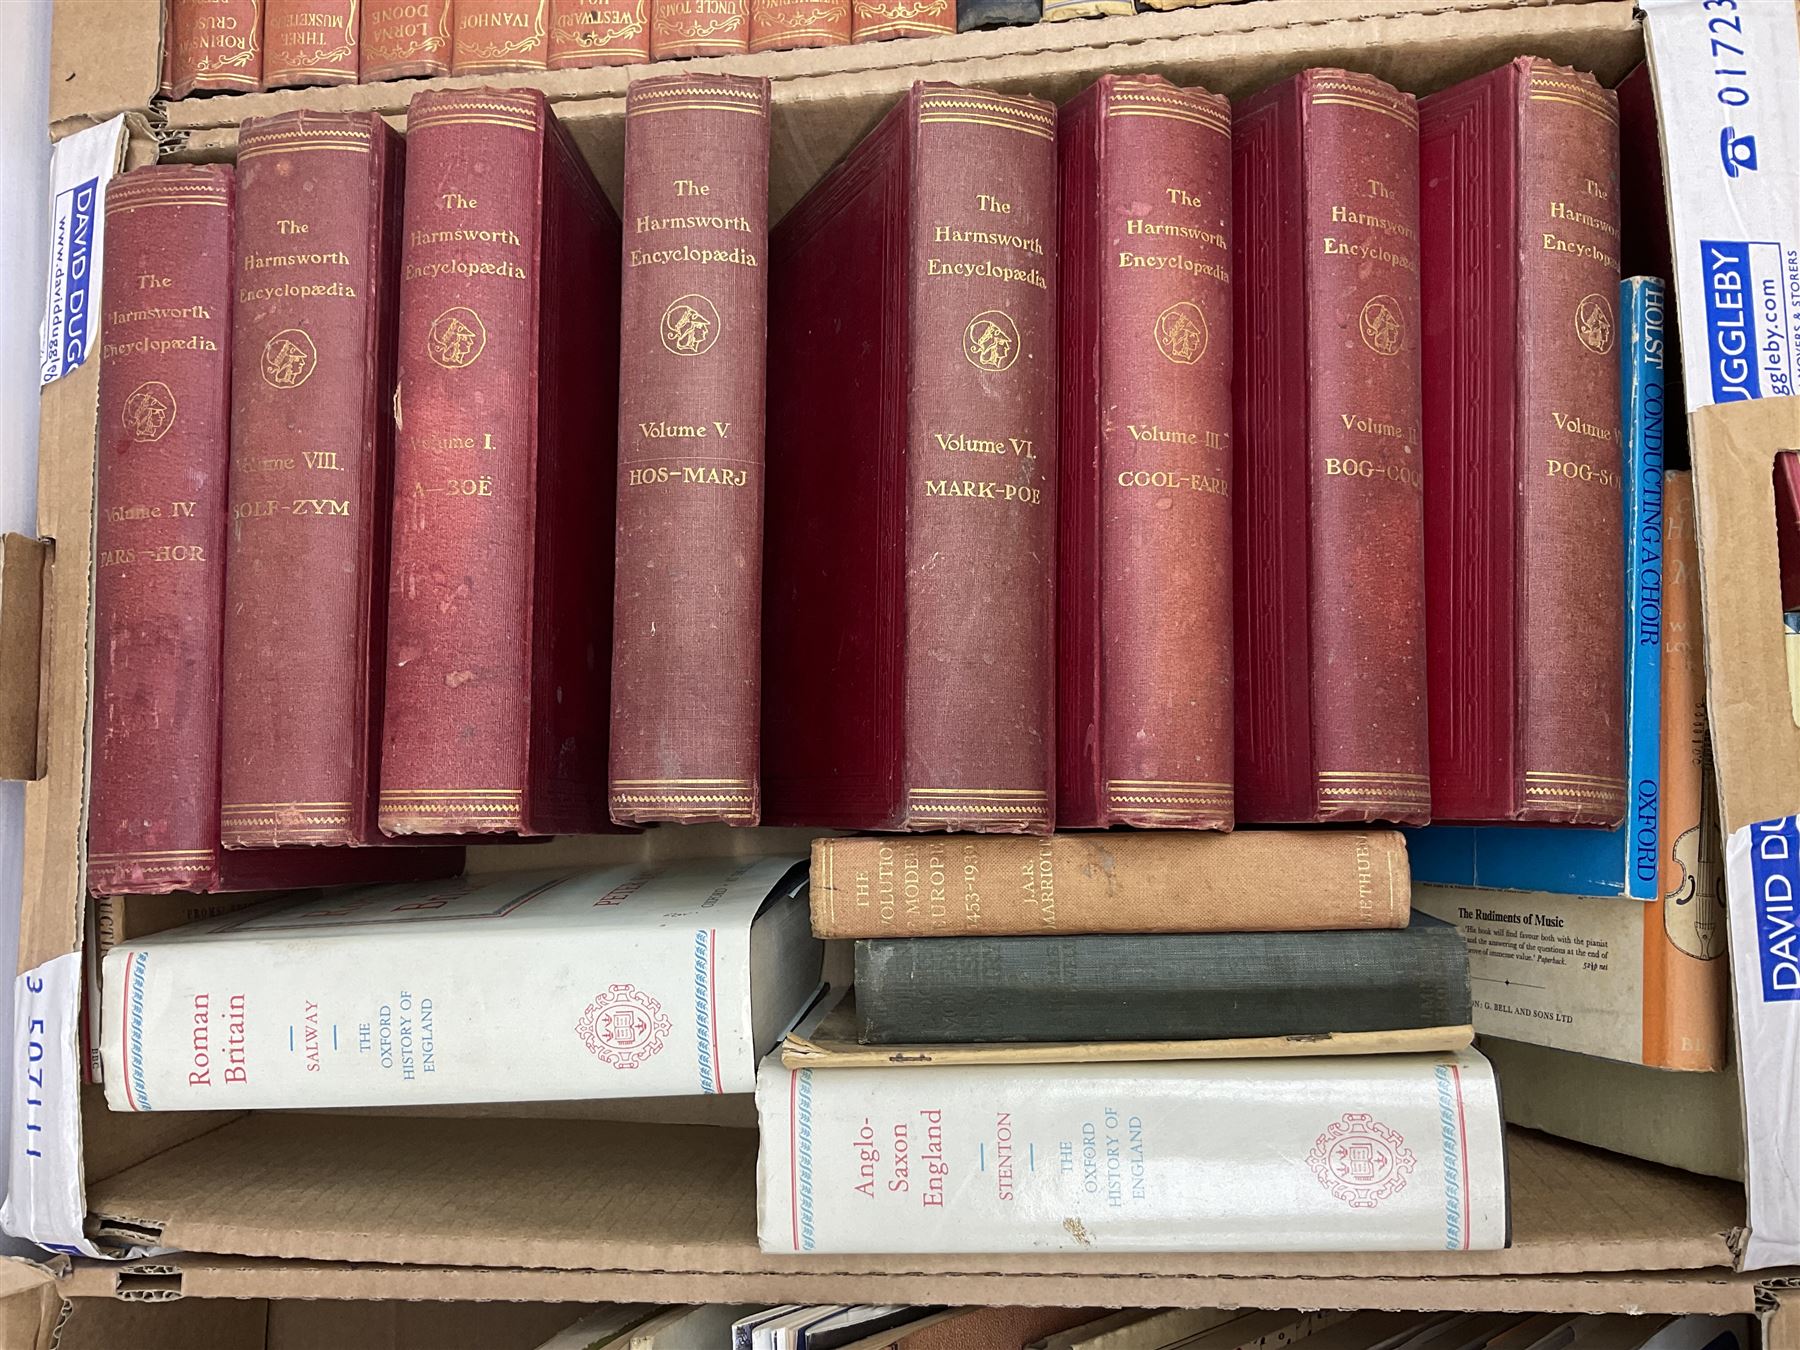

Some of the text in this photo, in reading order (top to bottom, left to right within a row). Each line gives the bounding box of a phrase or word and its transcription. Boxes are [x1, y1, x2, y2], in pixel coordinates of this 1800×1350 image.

[372, 5, 428, 25] DOONE
[558, 10, 633, 27] WESTWARD
[696, 0, 736, 15] UNCLE
[374, 23, 427, 42] LORNA
[674, 180, 710, 196] The
[1166, 188, 1202, 208] The
[1585, 179, 1608, 200] The
[442, 194, 478, 209] The
[976, 195, 1011, 214] The
[71, 188, 92, 281] DAVID
[277, 219, 309, 235] The
[636, 215, 751, 234] Harmsworth
[1126, 219, 1227, 250] Harmsworth
[411, 229, 521, 248] Harmsworth
[934, 226, 1044, 256] Harmsworth
[244, 251, 350, 271] Harmsworth
[630, 246, 758, 268] Encyclopædia
[1119, 252, 1230, 284] Encyclopædia
[138, 274, 172, 289] The
[406, 259, 526, 281] Encyclopædia
[927, 259, 1047, 290] Encyclopædia
[239, 282, 356, 304] Encyclopædia
[639, 421, 731, 439] Volume V.
[1127, 425, 1197, 445] Volume
[1341, 414, 1403, 438] Volume
[1551, 412, 1612, 440] Volume
[935, 434, 1006, 454] Volume
[629, 467, 748, 487] HOS-MARJ
[925, 480, 1041, 505] MARK-POE
[1637, 290, 1665, 883] HOLST CONDUCTING A CHOIR OXFORD
[1022, 860, 1038, 905] J.A.R.
[1458, 907, 1564, 928] The Rudiments of Music
[1478, 927, 1491, 936] book
[1493, 928, 1504, 937] will
[1506, 930, 1517, 938] find
[1519, 931, 1539, 941] favour
[1540, 933, 1555, 943] both
[1557, 935, 1572, 945] with
[1573, 937, 1584, 946] the
[1586, 939, 1608, 950] pianist
[1764, 874, 1800, 991] DAVID
[1518, 941, 1526, 950] of
[1526, 942, 1536, 951] the
[1537, 944, 1566, 955] questions
[1575, 947, 1586, 956] the
[1587, 949, 1600, 958] end
[1601, 950, 1609, 960] of
[1484, 1002, 1492, 1011] G.
[1494, 1003, 1513, 1014] BELL
[1514, 1007, 1532, 1017] AND
[1532, 1009, 1554, 1021] SONS
[1555, 1013, 1573, 1024] LTD
[188, 992, 211, 1088] Roman
[221, 993, 248, 1085] Britain
[305, 999, 321, 1072] SALWAY
[359, 1022, 371, 1053] THE
[379, 1004, 393, 1069] OXFORD
[400, 990, 416, 1081] HISTORY OF
[421, 997, 436, 1073] ENGLAND
[26, 1015, 44, 1158] 507111
[853, 1116, 880, 1199] Anglo-
[888, 1122, 910, 1194] Saxon
[920, 1108, 949, 1208] England
[996, 1111, 1014, 1201] STENTON
[1060, 1141, 1073, 1175] THE
[1081, 1121, 1098, 1195] OXFORD
[1104, 1106, 1122, 1208] HISTORY OF
[1128, 1115, 1145, 1200] ENGLAND
